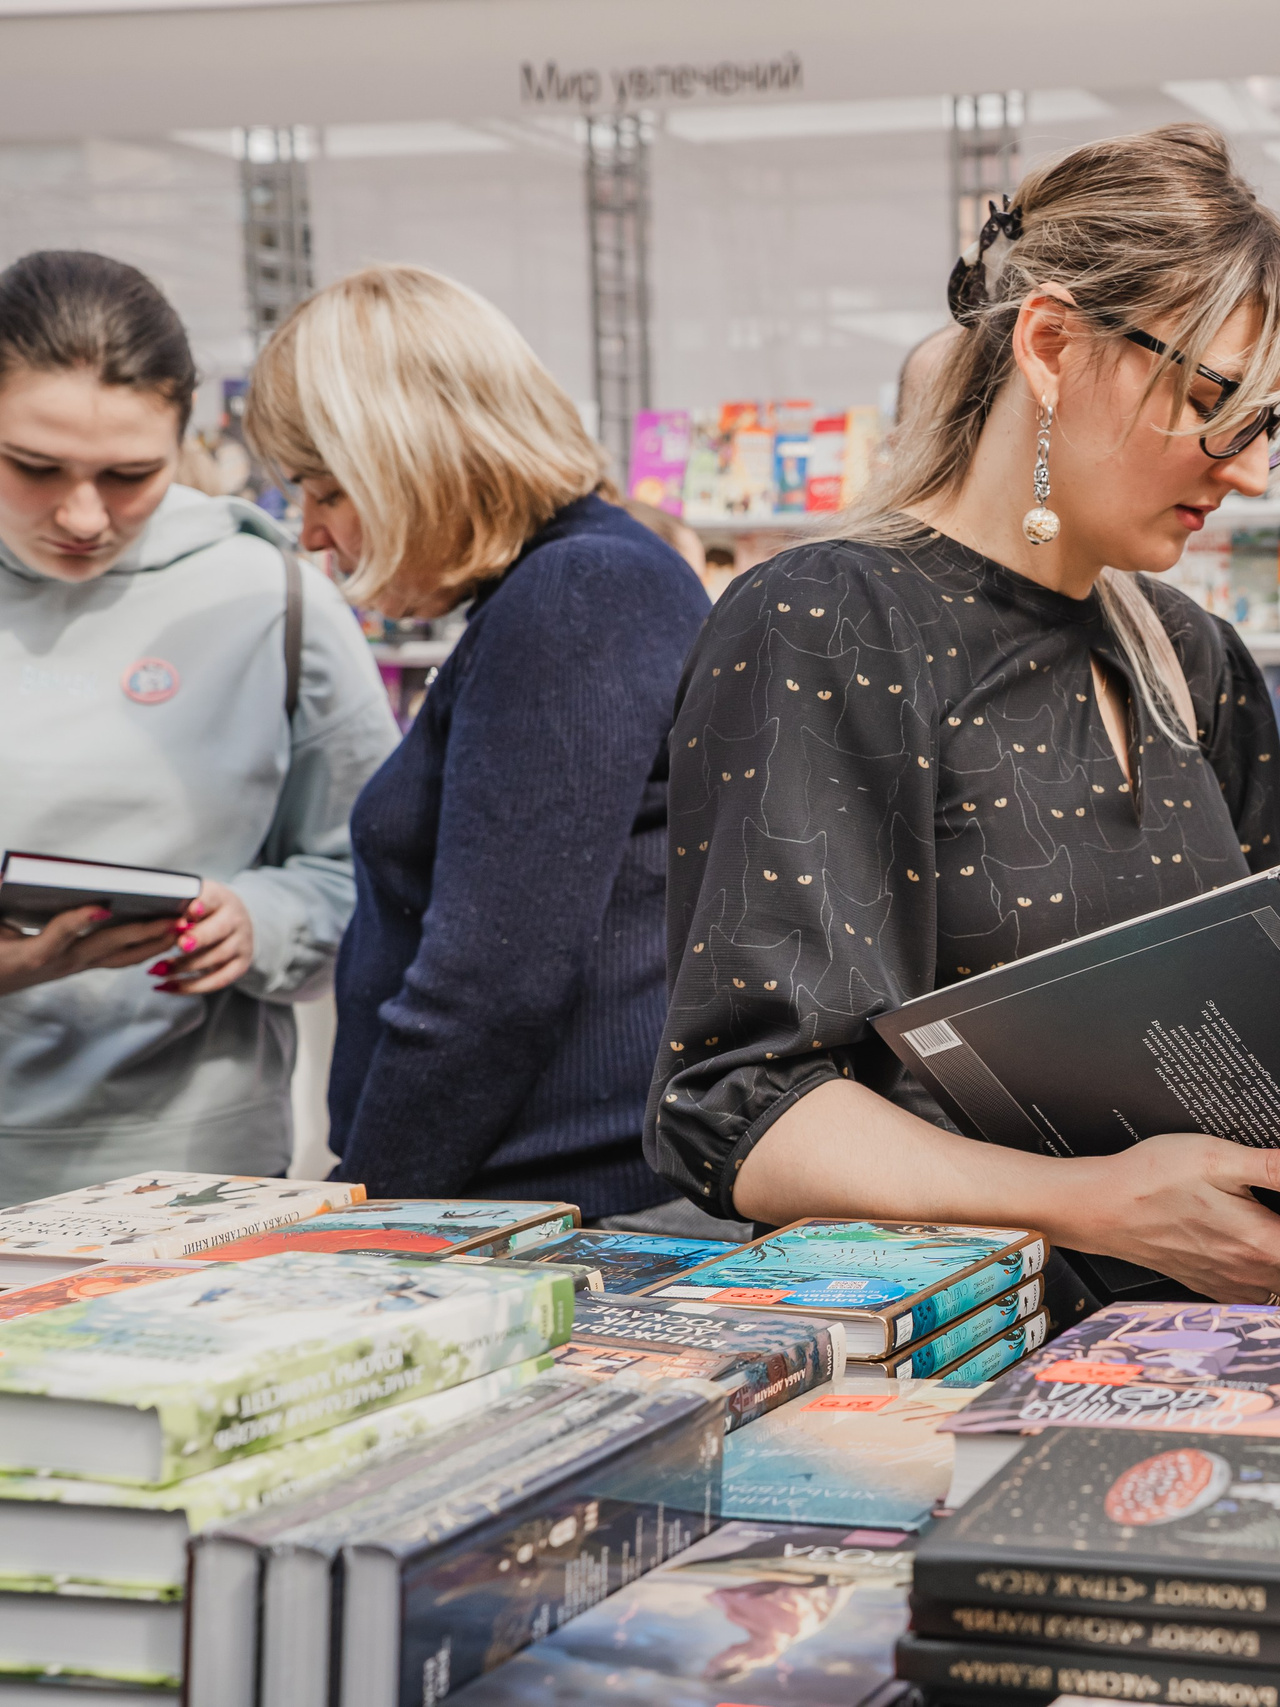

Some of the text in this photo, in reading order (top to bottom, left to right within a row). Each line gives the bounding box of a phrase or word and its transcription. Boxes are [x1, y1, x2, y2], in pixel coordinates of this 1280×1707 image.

[519, 52, 804, 114] Мир увлечений
[1205, 999, 1220, 1016] Эта
[1218, 1017, 1241, 1042] книга
[1200, 1009, 1212, 1021] по
[1210, 1021, 1256, 1076] воссозданию
[1200, 1023, 1242, 1073] выживания
[1239, 1074, 1251, 1085] до
[1141, 1037, 1159, 1056] наш
[1157, 1056, 1174, 1074] мир
[1178, 1082, 1193, 1098] как
[1190, 1098, 1206, 1115] при
[1146, 1028, 1177, 1062] помогут
[1174, 1063, 1190, 1080] вам
[1186, 1080, 1230, 1133] разобраться,
[1150, 1019, 1202, 1081] Великолепные
[1200, 1082, 1240, 1128] подробные
[1169, 1028, 1199, 1063] великое
[1196, 1064, 1239, 1114] достижение
[1177, 1024, 1221, 1079] инструкцию,
[1221, 1079, 1236, 1095] как
[1234, 1095, 1269, 1139] повторить
[1200, 1038, 1234, 1078] культуры
[1240, 1088, 1259, 1111] здесь
[1258, 1112, 1271, 1125] вы
[1154, 1066, 1202, 1123] построить его
[182, 1210, 300, 1256] СЛУЖБА ДОСТАВКИ КНИГ
[973, 1274, 996, 1290] ГРИГОРЕНКО
[973, 1284, 995, 1300] АЛЕКСАНДР
[571, 1322, 727, 1348] КНИЖНЫ
[585, 1305, 757, 1333] В ТОСКАНЕ
[592, 1315, 718, 1336] ДОМИК
[971, 1316, 994, 1332] ГРИГОРЕНКО
[971, 1326, 992, 1343] АЛЕКСАНДР
[754, 1367, 807, 1404] АЛЬБА ДОНАТИ
[1045, 1381, 1264, 1412] ДЕВОЧКА
[1017, 1398, 1244, 1432] ОДАРЕННАЯ
[722, 1483, 875, 1501] ХИЛЬДЕБРА
[1152, 1579, 1267, 1612] БЛОКНОТ
[1147, 1623, 1260, 1657] БЛОКНОТ
[1166, 1676, 1278, 1707] БЛОКНОТ
